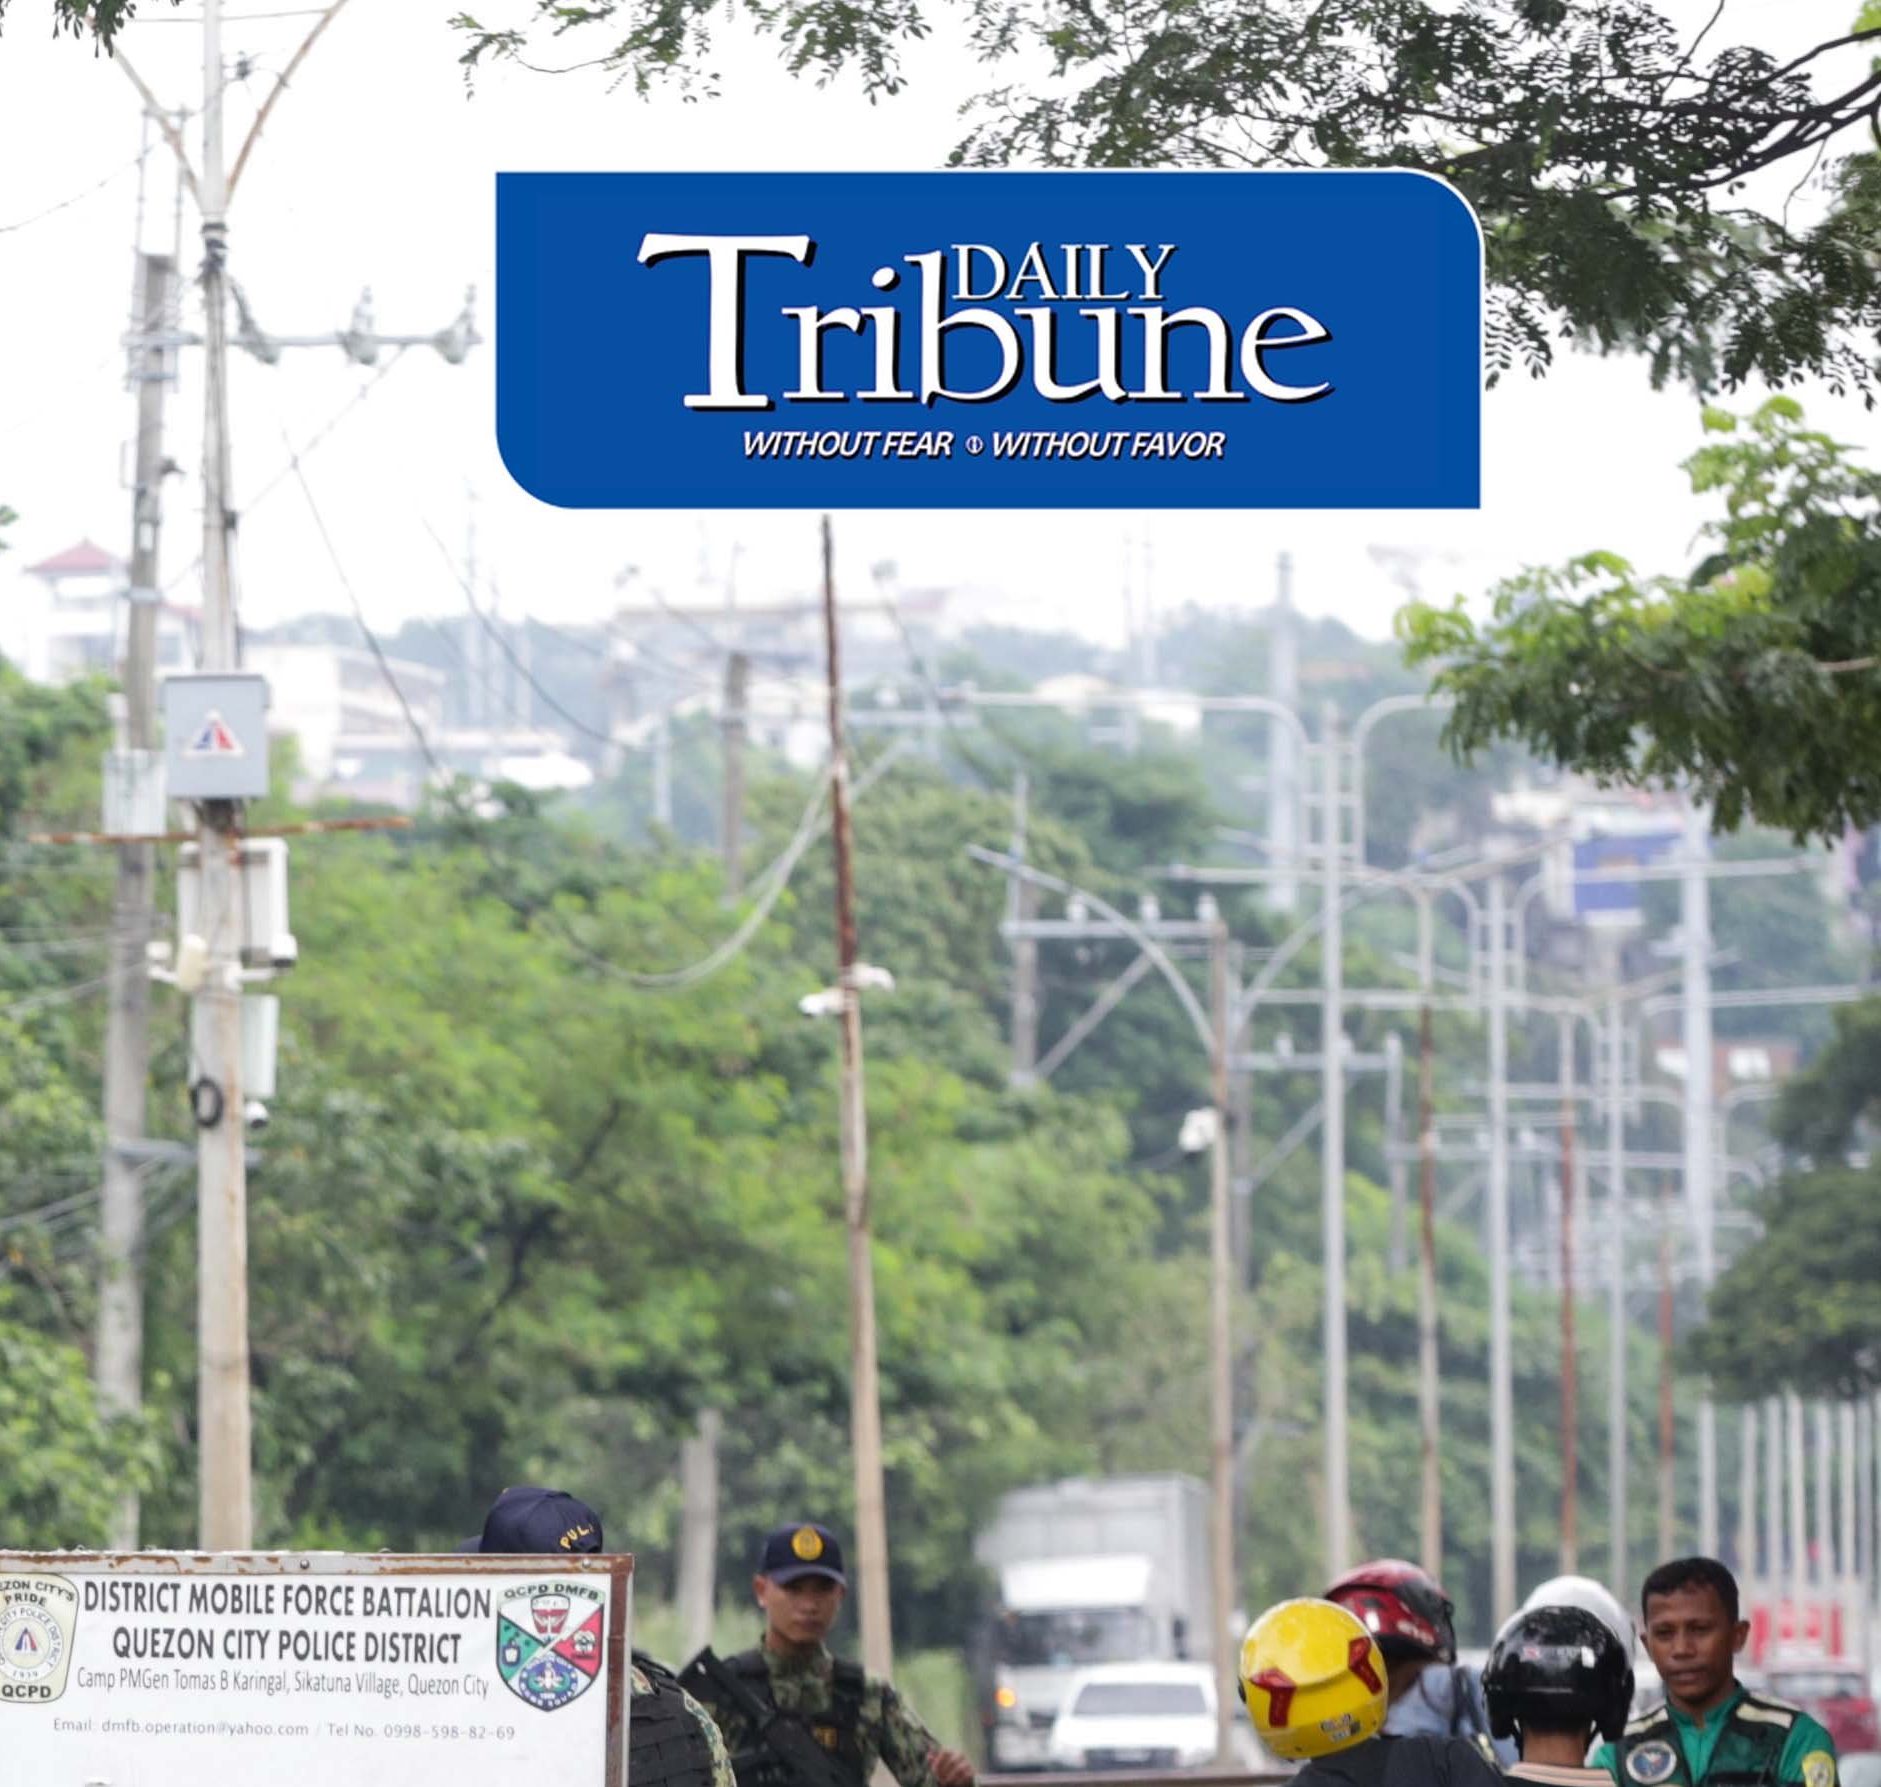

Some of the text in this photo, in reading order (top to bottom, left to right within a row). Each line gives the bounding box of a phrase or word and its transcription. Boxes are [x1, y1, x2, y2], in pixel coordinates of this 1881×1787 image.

[4, 1592, 47, 1607] PRIDE
[84, 1581, 491, 1620] DISTRICT MOBILE FORCE BATTALION
[504, 1584, 598, 1601] QCPD DMFB
[113, 1627, 462, 1665] QUEZON CITY POLICE DISTRICT
[1, 1684, 52, 1699] QCPD
[77, 1667, 489, 1700] Camp PMGen Tomas B Karingal, Sikatuna Village, Quezon City
[329, 1723, 349, 1736] Tel
[384, 1725, 515, 1740] 0998-598-82-69
